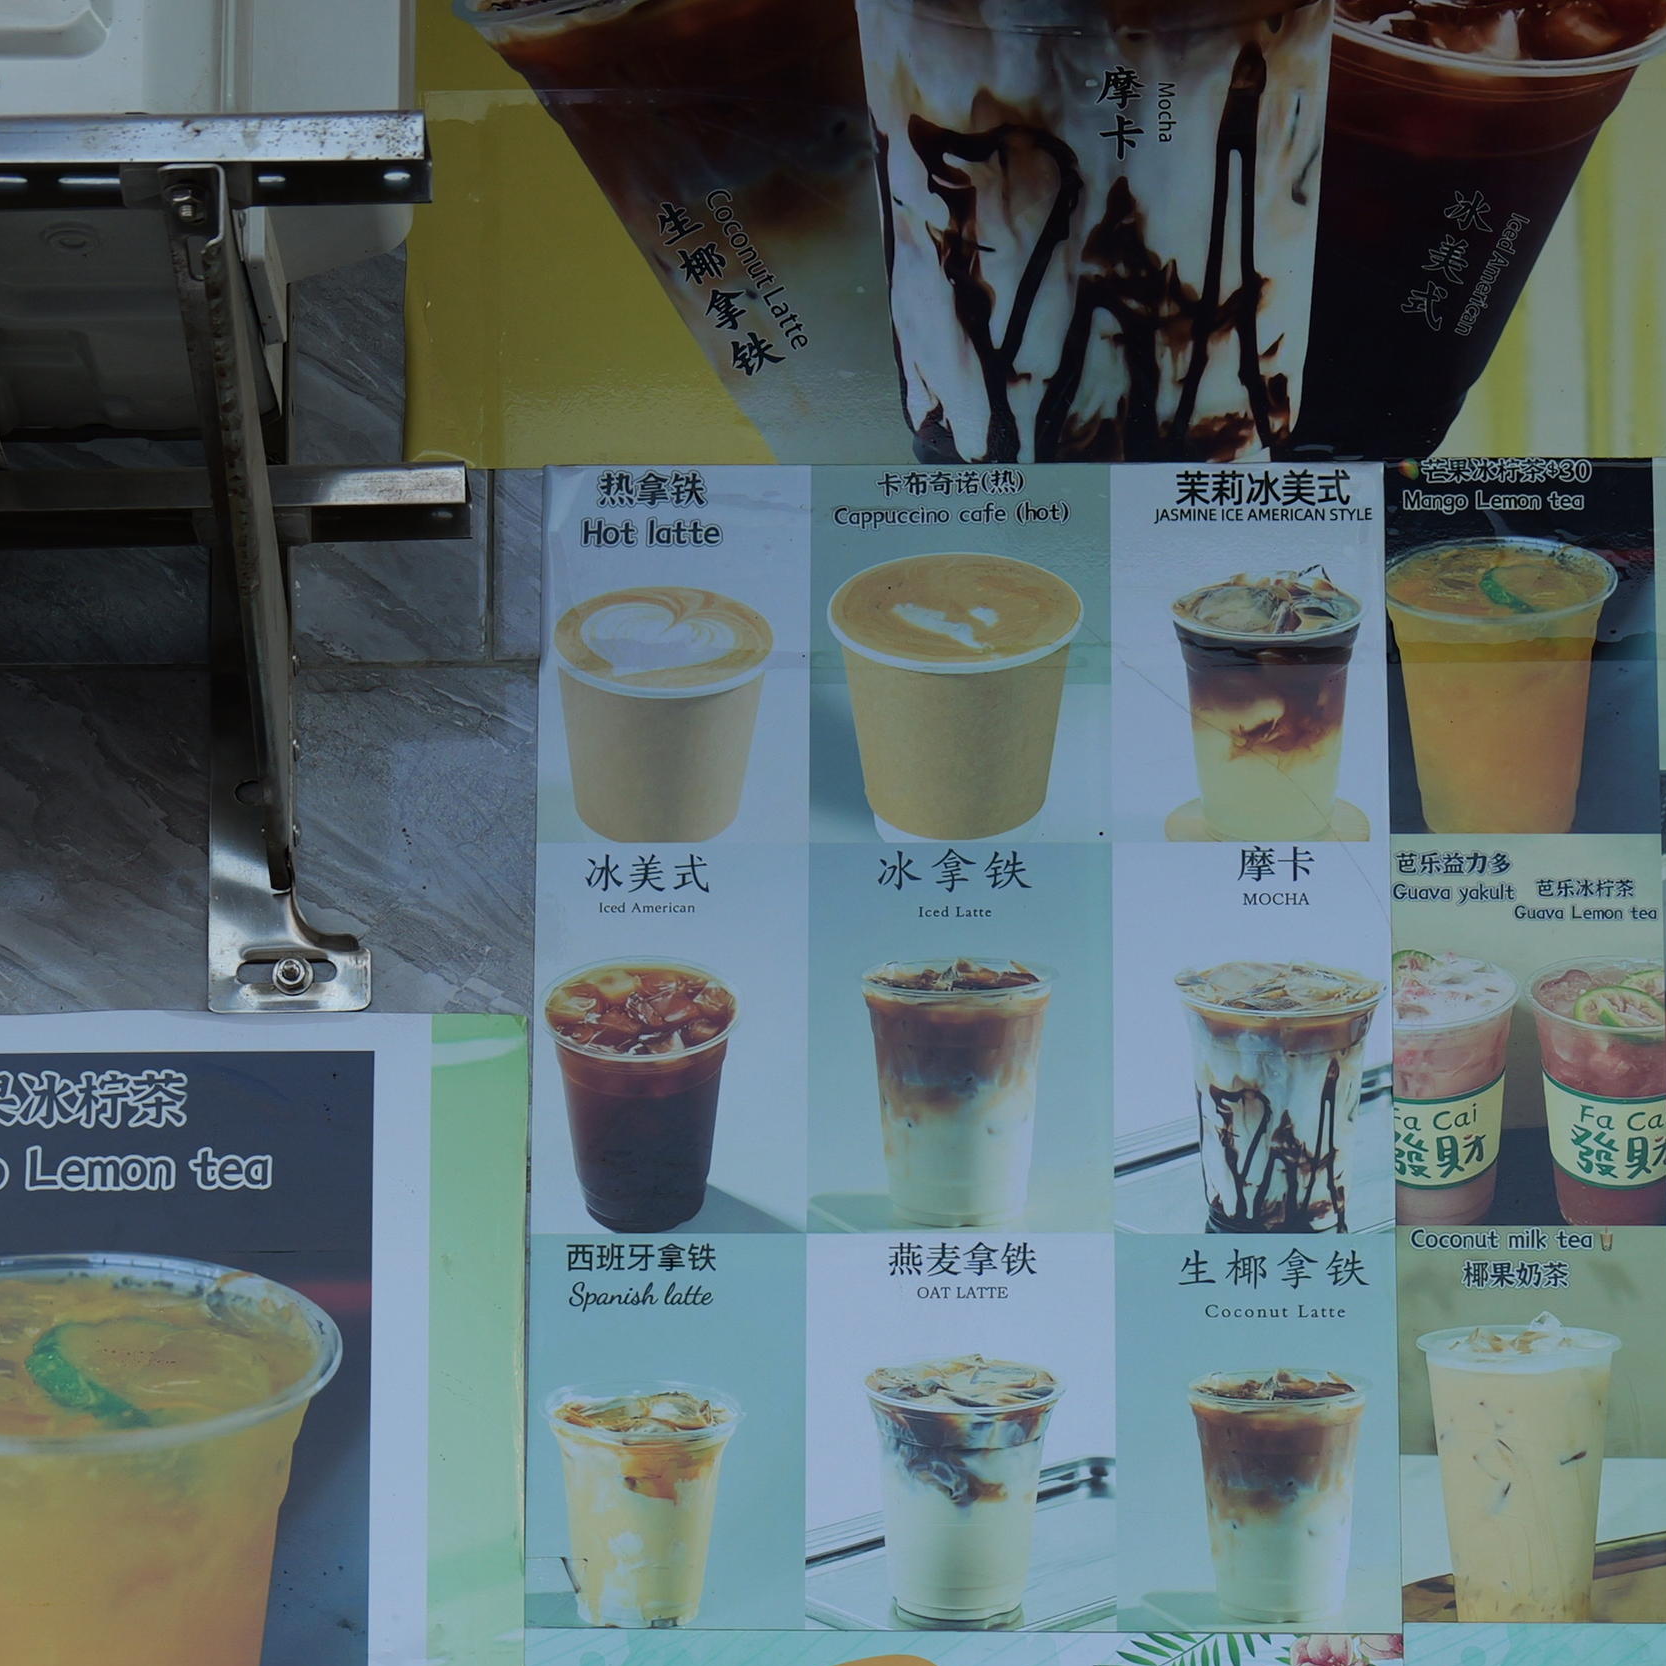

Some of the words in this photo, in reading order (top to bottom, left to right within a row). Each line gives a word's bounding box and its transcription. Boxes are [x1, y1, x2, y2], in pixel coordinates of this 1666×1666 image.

[1096, 66, 1146, 160] 摩卡
[1158, 82, 1177, 142] Mocha
[1496, 213, 1531, 255] Iced
[705, 189, 774, 289] Coconut
[762, 286, 808, 350] Latte
[1400, 190, 1493, 331] 冰美式
[657, 202, 786, 375] 生椰拿铁
[1454, 251, 1509, 336] American
[599, 472, 706, 506] 热拿铁
[878, 469, 1024, 496] 卡布奇诺(热)
[1176, 469, 1351, 506] 茉莉冰美式
[834, 506, 950, 529] Cappuccino
[960, 502, 1006, 522] cafe
[1016, 501, 1069, 523] (hot)
[1154, 508, 1216, 524] JASMINE
[1222, 508, 1244, 521] ICE
[1247, 508, 1325, 521] AMERICAN
[1330, 507, 1372, 521] STYLE
[1403, 490, 1468, 514] Mango
[1476, 490, 1542, 510] Lemon
[1547, 491, 1584, 510] tea
[584, 518, 636, 545] Hot
[648, 518, 720, 545] latte
[585, 853, 710, 893] 冰美式
[877, 848, 1033, 893] 冰拿铁
[1237, 845, 1315, 882] 摩卡
[1396, 852, 1511, 875] 芭乐益力多
[1243, 892, 1309, 906] MOCHA
[1393, 883, 1450, 900] Guava
[1460, 884, 1515, 905] yakult
[1536, 878, 1634, 898] 芭乐冰柠茶
[599, 902, 626, 913] Iced
[631, 902, 695, 913] American
[919, 906, 949, 917] Iced
[956, 906, 992, 917] Latte
[1514, 905, 1563, 919] Guava
[1572, 905, 1622, 919] Lemon
[1632, 906, 1657, 919] tea
[1433, 1103, 1477, 1131] Cai
[1580, 1104, 1614, 1130] Fa
[24, 1146, 177, 1192] Lemon
[190, 1147, 273, 1191] tea
[1411, 1229, 1498, 1249] Coconut
[1508, 1229, 1546, 1249] milk
[1556, 1231, 1592, 1248] tea
[566, 1243, 717, 1271] 西班牙拿铁
[888, 1241, 1037, 1277] 燕麦拿铁
[1178, 1247, 1370, 1290] 生椰拿铁
[1464, 1261, 1569, 1288] 椰果奶茶
[568, 1281, 658, 1312] Spanish
[664, 1281, 713, 1306] latte
[917, 1286, 951, 1299] OAT
[956, 1286, 1009, 1299] LATTE
[1205, 1304, 1288, 1318] Coconut
[1298, 1304, 1346, 1318] Latte
